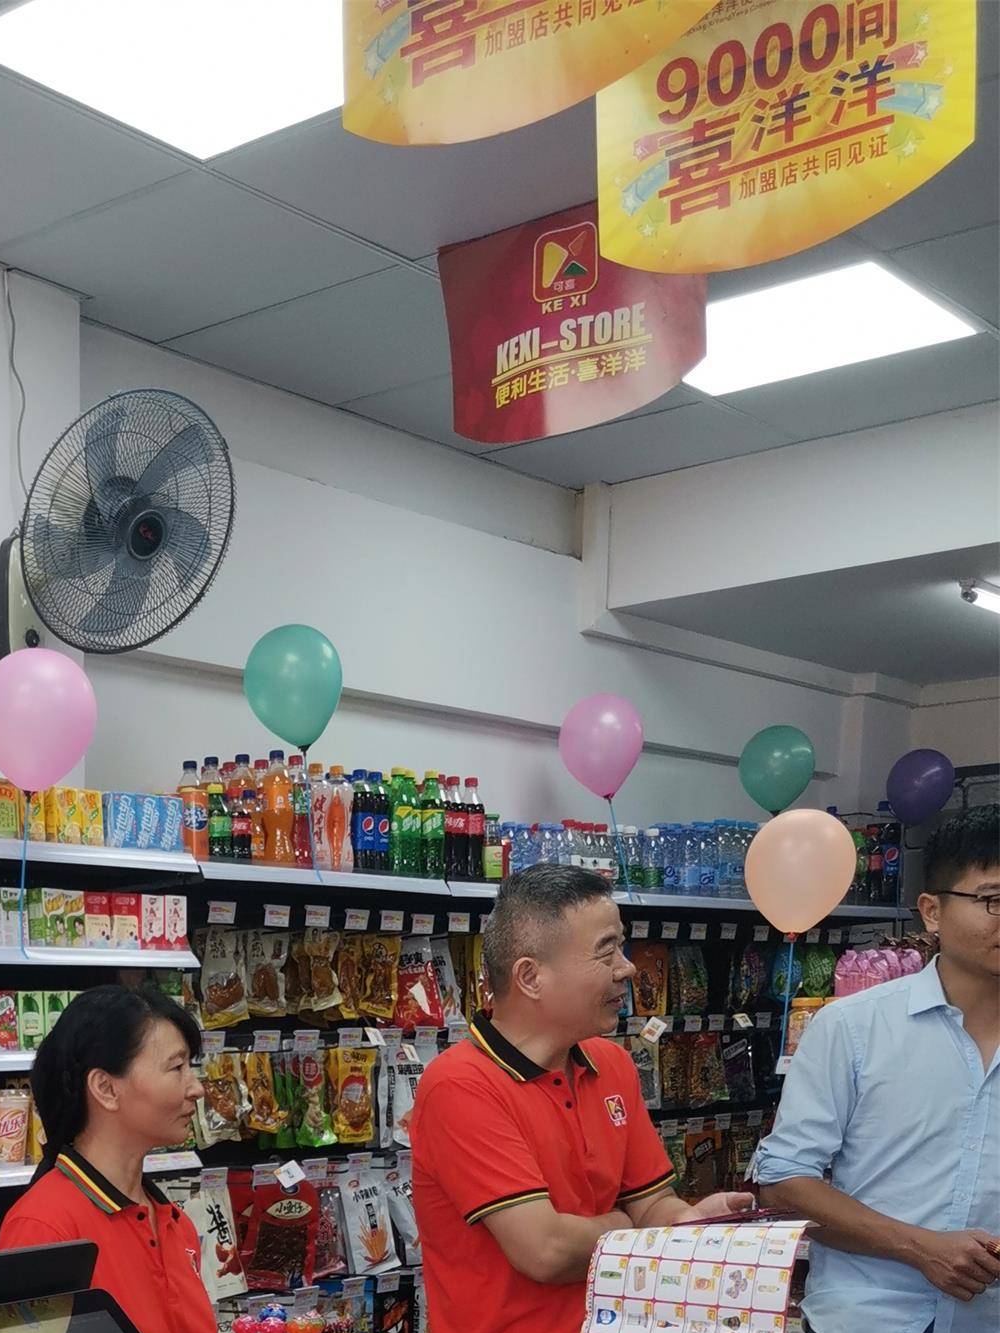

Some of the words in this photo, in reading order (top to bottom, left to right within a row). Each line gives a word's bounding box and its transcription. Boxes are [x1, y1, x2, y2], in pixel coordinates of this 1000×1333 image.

[658, 55, 895, 225] 喜洋洋
[739, 134, 889, 200] 加盟店共同见证
[542, 299, 564, 315] KE
[569, 293, 588, 309] XI
